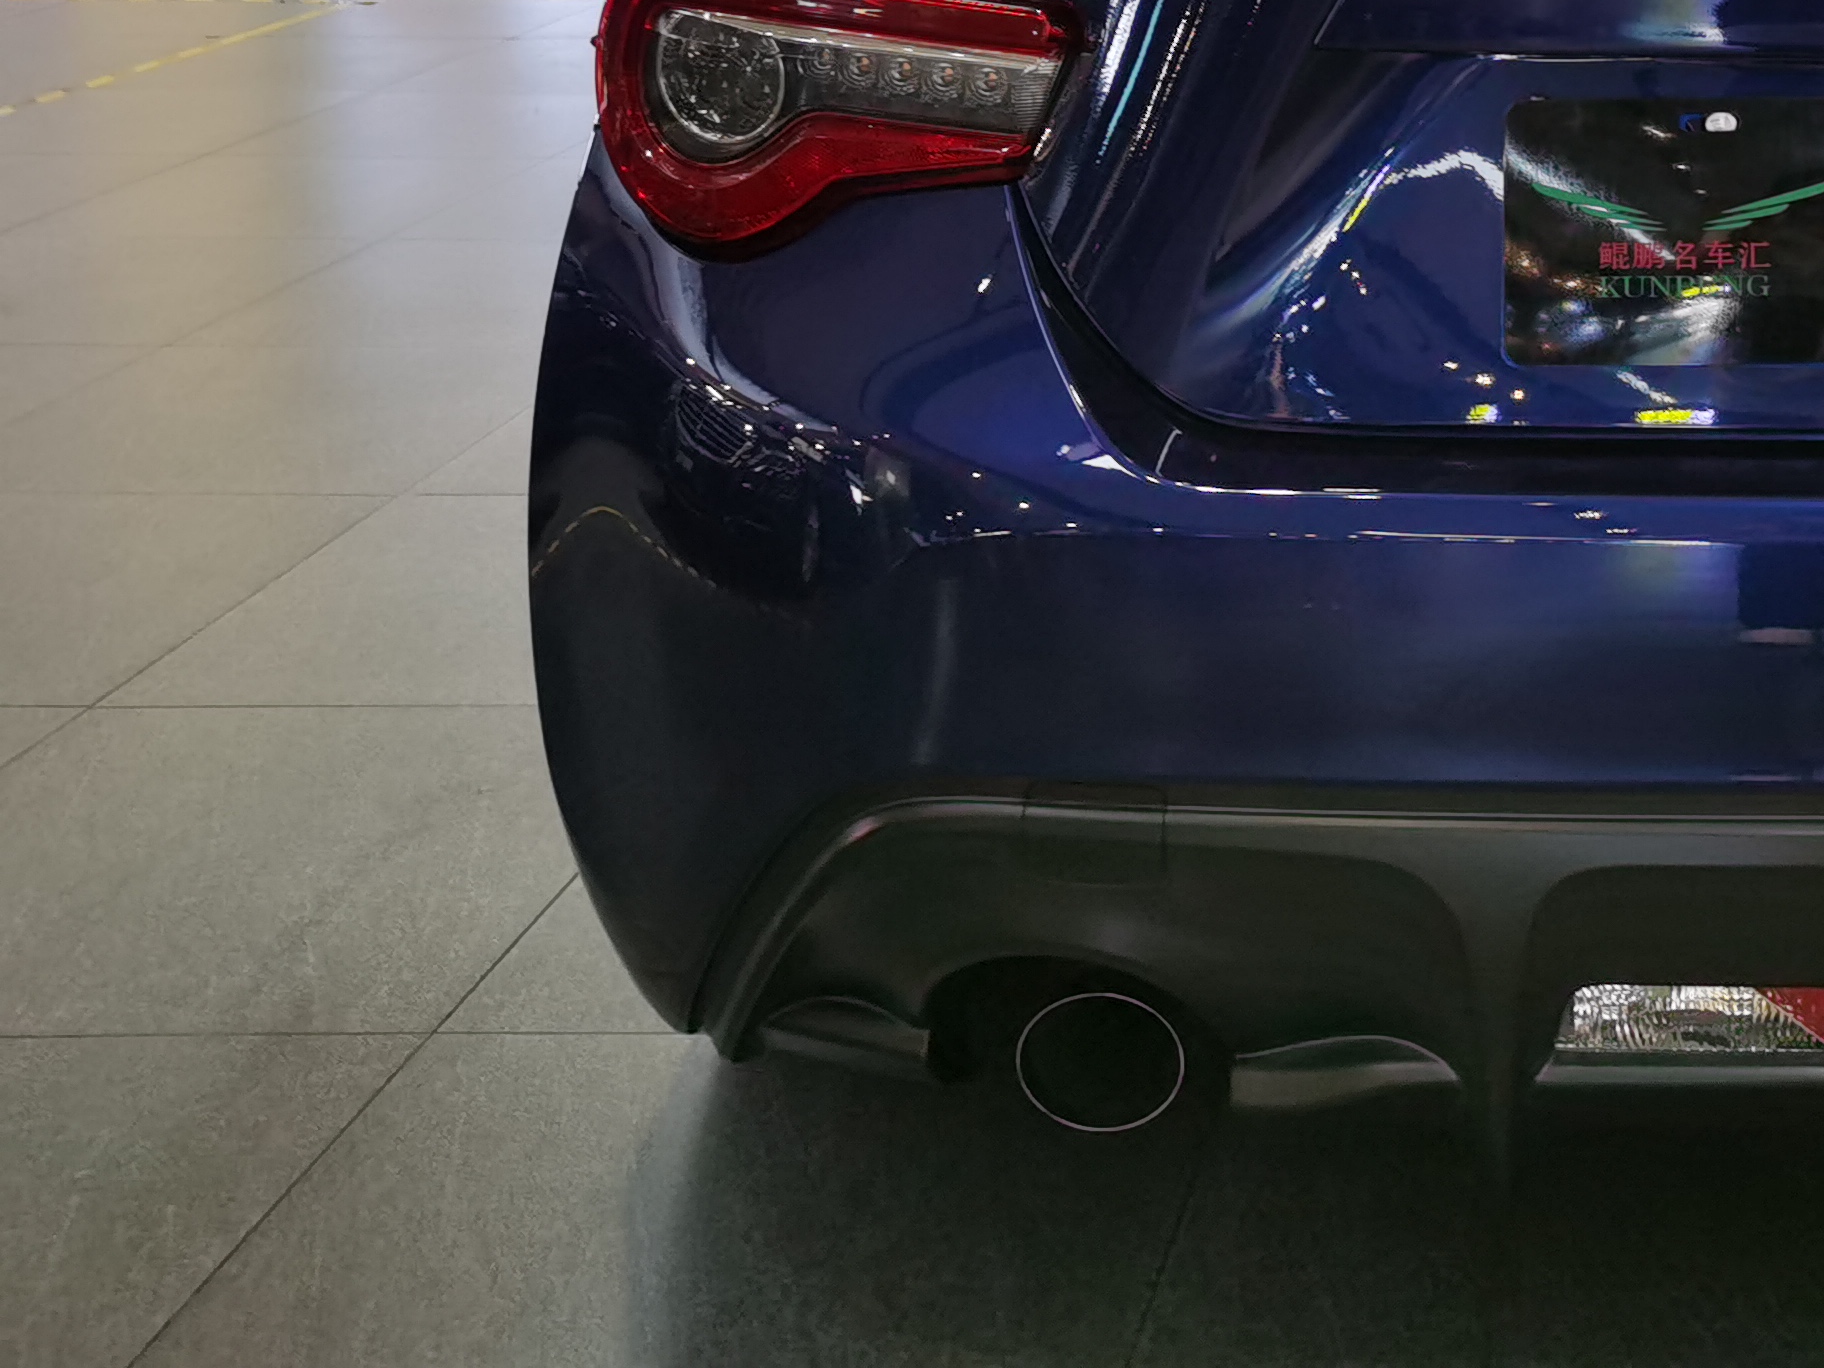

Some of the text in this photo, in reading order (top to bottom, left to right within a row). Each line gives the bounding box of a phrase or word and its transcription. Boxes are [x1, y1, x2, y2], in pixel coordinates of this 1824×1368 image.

[1599, 240, 1772, 271] 鲲鹏名车汇
[1600, 274, 1772, 300] KUNPNG
